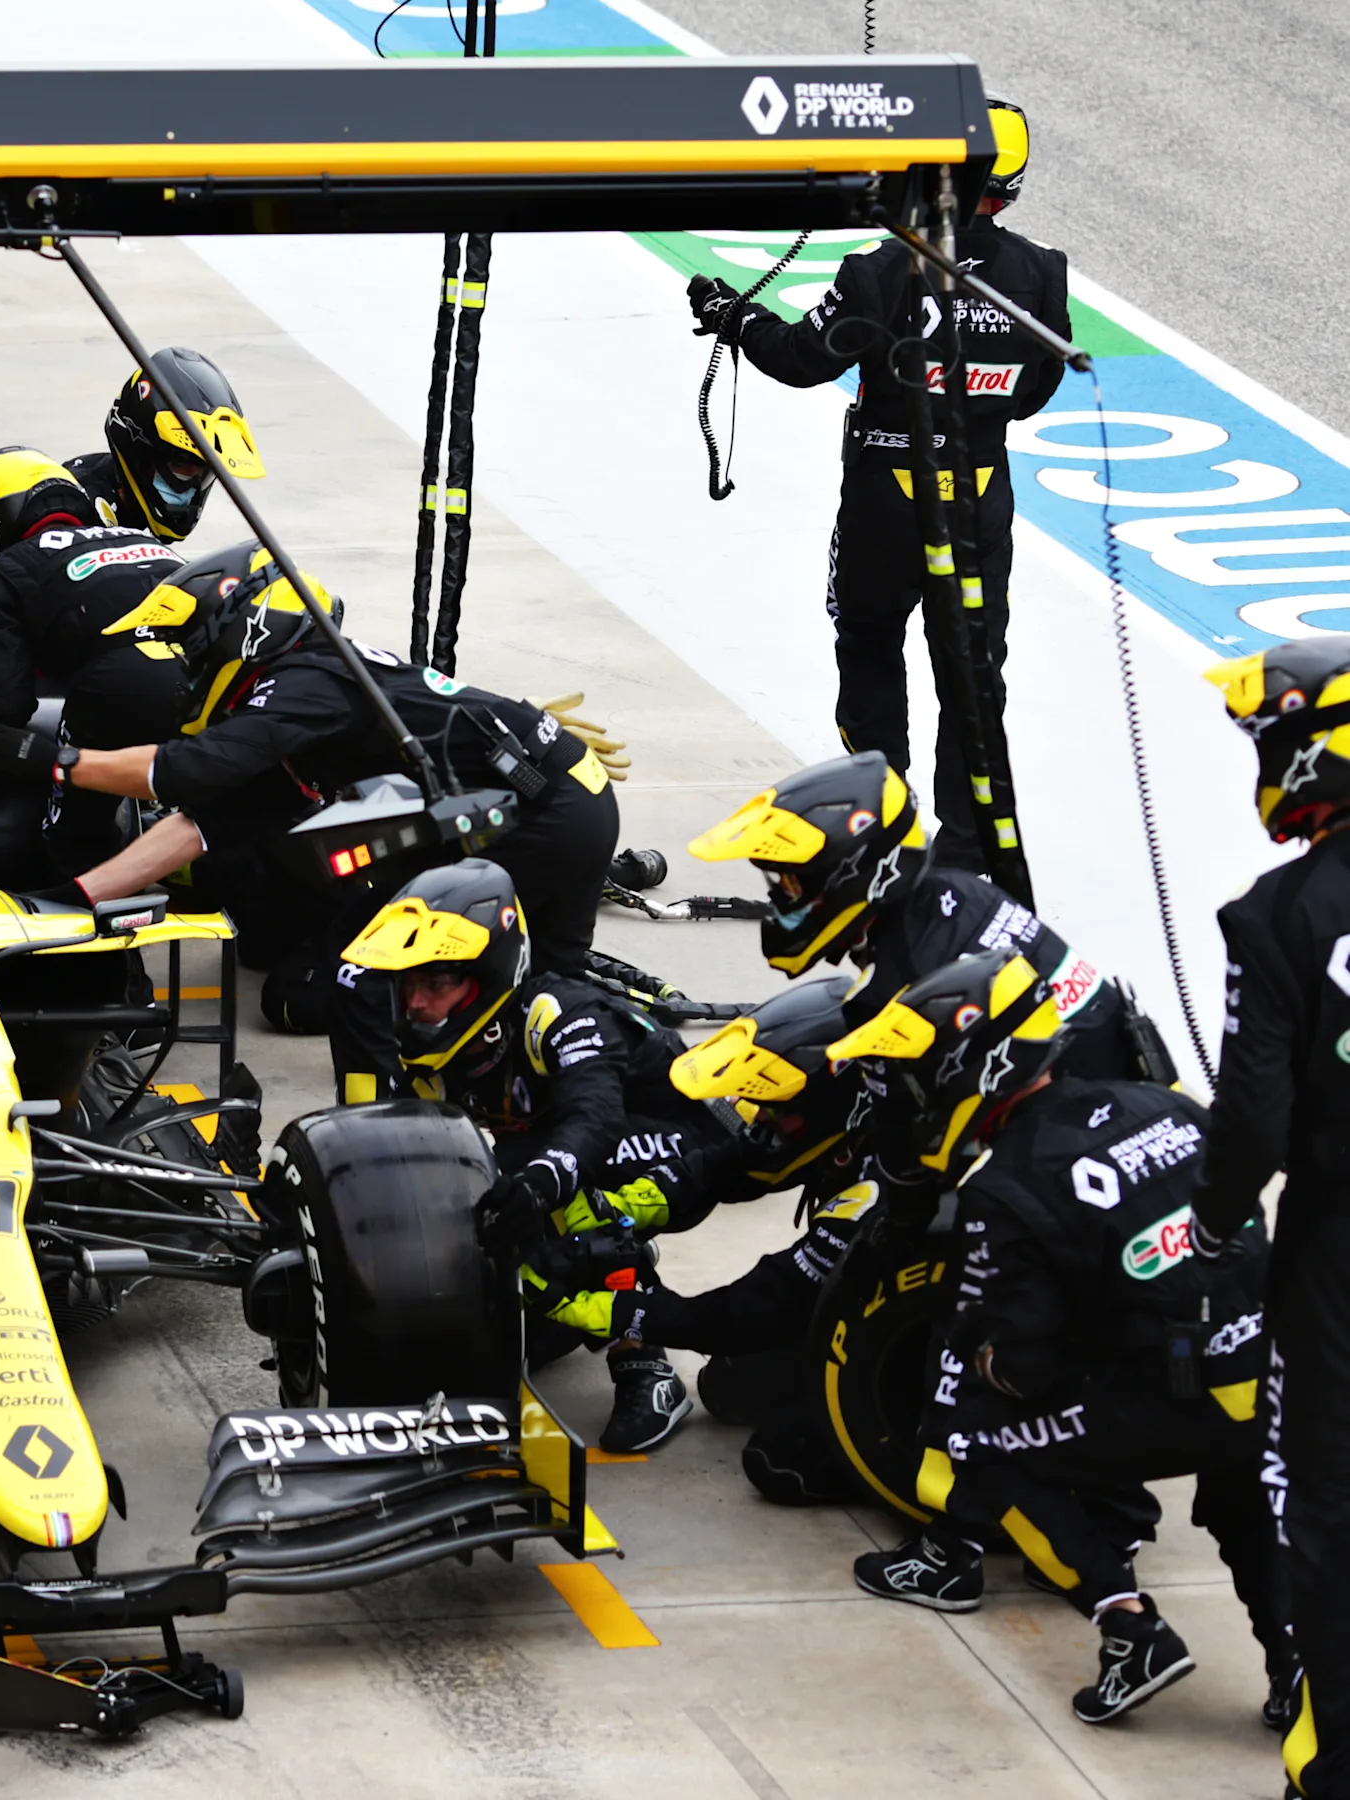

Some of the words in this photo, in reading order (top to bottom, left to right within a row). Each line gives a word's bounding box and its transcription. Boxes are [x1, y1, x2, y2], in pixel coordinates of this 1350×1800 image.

[794, 83, 884, 97] RENAULT
[795, 97, 828, 115] DP
[829, 96, 914, 116] WORLD
[796, 115, 819, 128] F1
[831, 115, 887, 128] TEAM
[969, 323, 1011, 334] TEAM
[926, 366, 1012, 391] Ctrol
[121, 914, 151, 928] Castrol
[563, 1017, 596, 1035] WORLD
[608, 1132, 682, 1165] AULT
[1107, 1116, 1175, 1159] RENAULT
[1117, 1151, 1147, 1175] DP
[1146, 1123, 1202, 1160] WORLD
[1154, 1142, 1198, 1170] TEAM
[285, 1163, 302, 1186] P
[298, 1204, 328, 1375] ZERO
[229, 1416, 306, 1462] DP
[307, 1404, 510, 1456] WORLD
